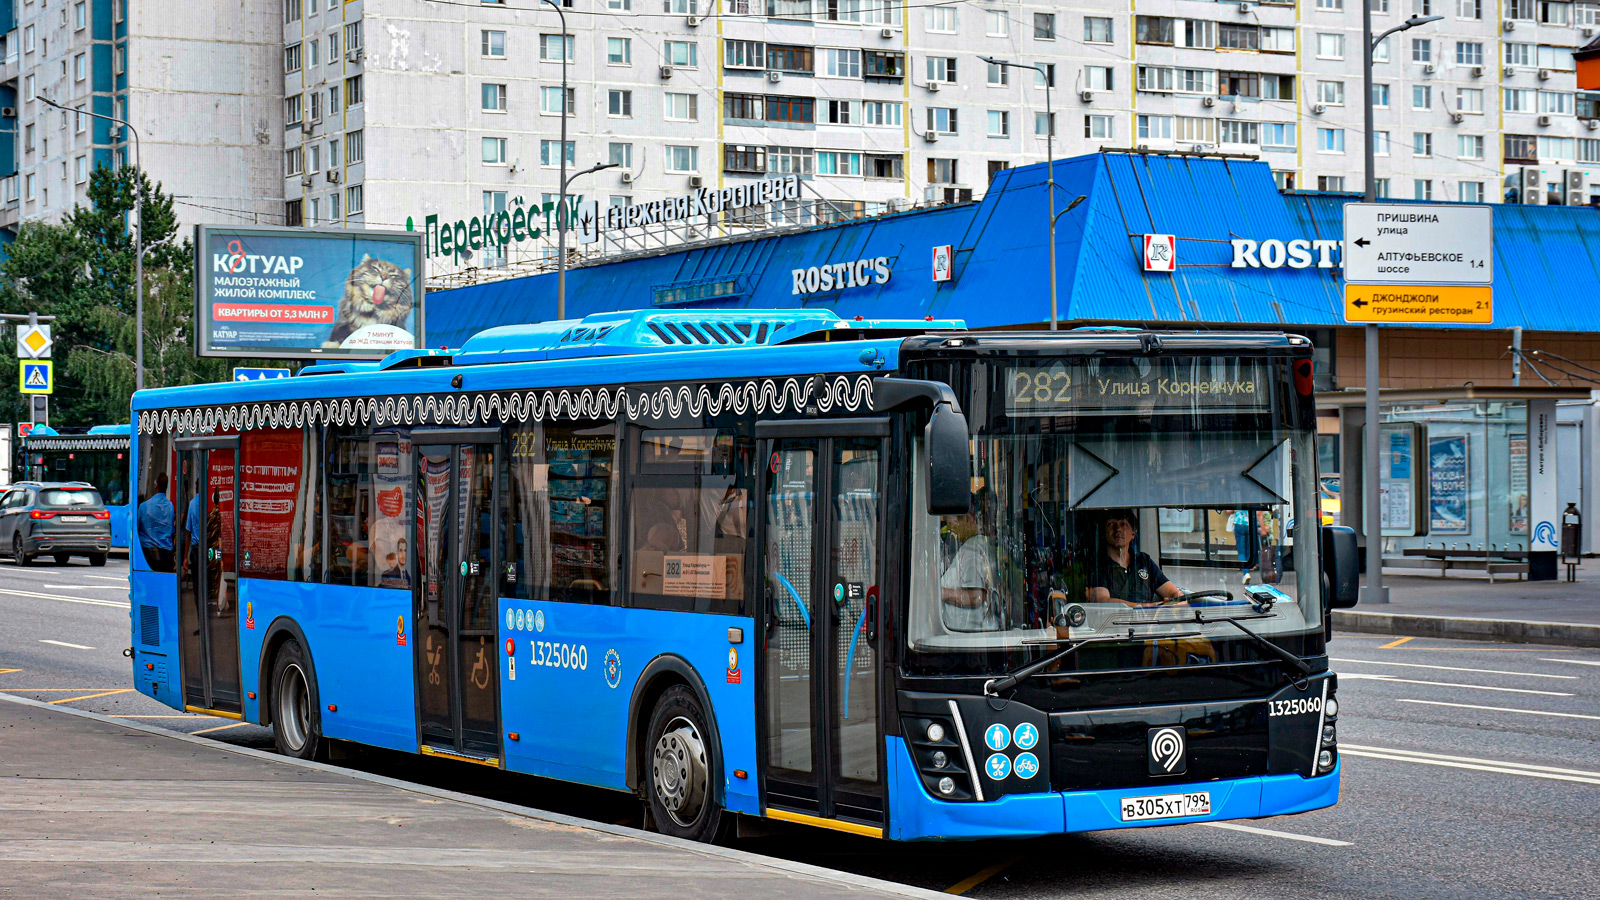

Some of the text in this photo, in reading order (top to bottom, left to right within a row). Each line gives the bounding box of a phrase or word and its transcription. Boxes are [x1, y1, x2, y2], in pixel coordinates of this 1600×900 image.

[694, 174, 799, 215] Королева
[1377, 213, 1439, 223] ПРИШВИНА
[425, 194, 585, 267] Перекрёсток
[1377, 227, 1408, 236] улица
[1377, 252, 1463, 262] АЛТУФЬЕВСКОЕ
[213, 253, 304, 275] КОТУАР
[1377, 266, 1410, 274] шоссе
[1470, 260, 1485, 268] 1.4
[214, 276, 300, 288] МАЛОЭТАЖНЫЙ
[791, 256, 892, 296] ROSTIC'S
[214, 287, 316, 300] ЖИЛОЙ КОМПЛЕКС
[1372, 293, 1440, 304] ДЖОНДЖОЛИ
[1372, 306, 1474, 316] грузинский ресторан
[1476, 301, 1489, 310] 2.1
[218, 308, 268, 317] КВАРТИРЫ
[269, 309, 282, 317] ОТ
[284, 309, 297, 319] 5,3
[299, 310, 320, 319] МЛН
[1014, 371, 1072, 403] 282
[1098, 378, 1256, 395] Улица Корнейчука
[512, 432, 536, 457] 282
[667, 562, 680, 575] 282
[530, 640, 588, 670] 1325060
[1268, 697, 1321, 717] 1325060
[1126, 798, 1182, 817] В305ХТ
[1185, 794, 1206, 808] 799
